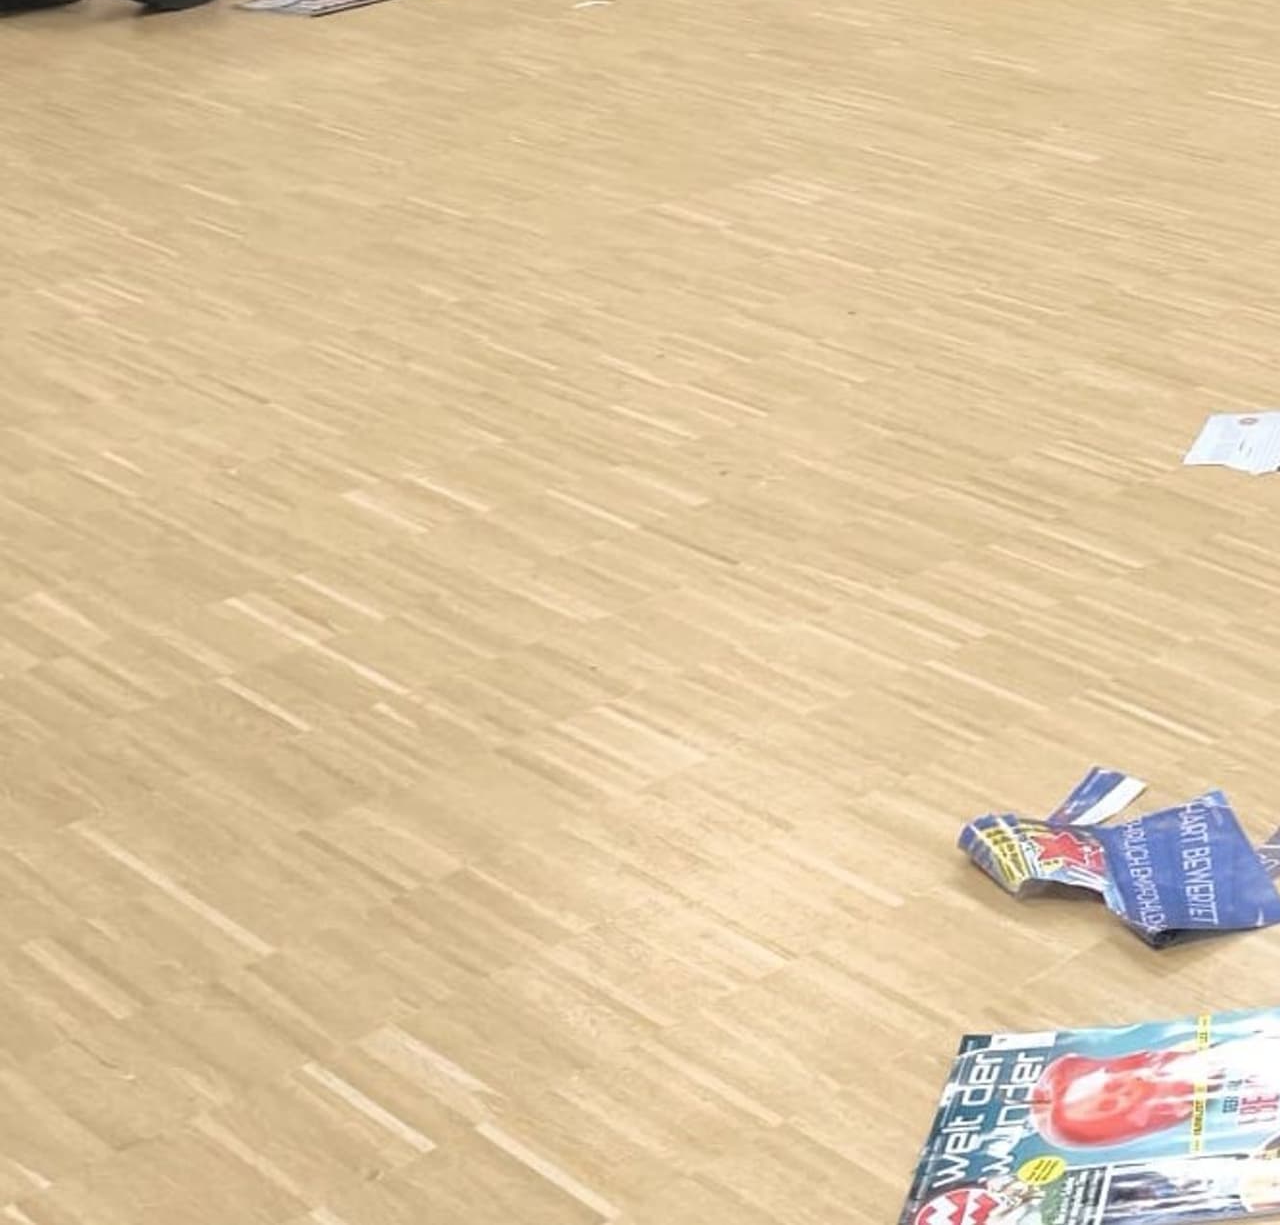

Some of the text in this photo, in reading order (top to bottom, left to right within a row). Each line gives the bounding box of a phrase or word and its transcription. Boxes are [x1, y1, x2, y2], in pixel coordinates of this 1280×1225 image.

[1181, 847, 1219, 925] BEWERTET
[932, 1052, 1003, 1188] welt der
